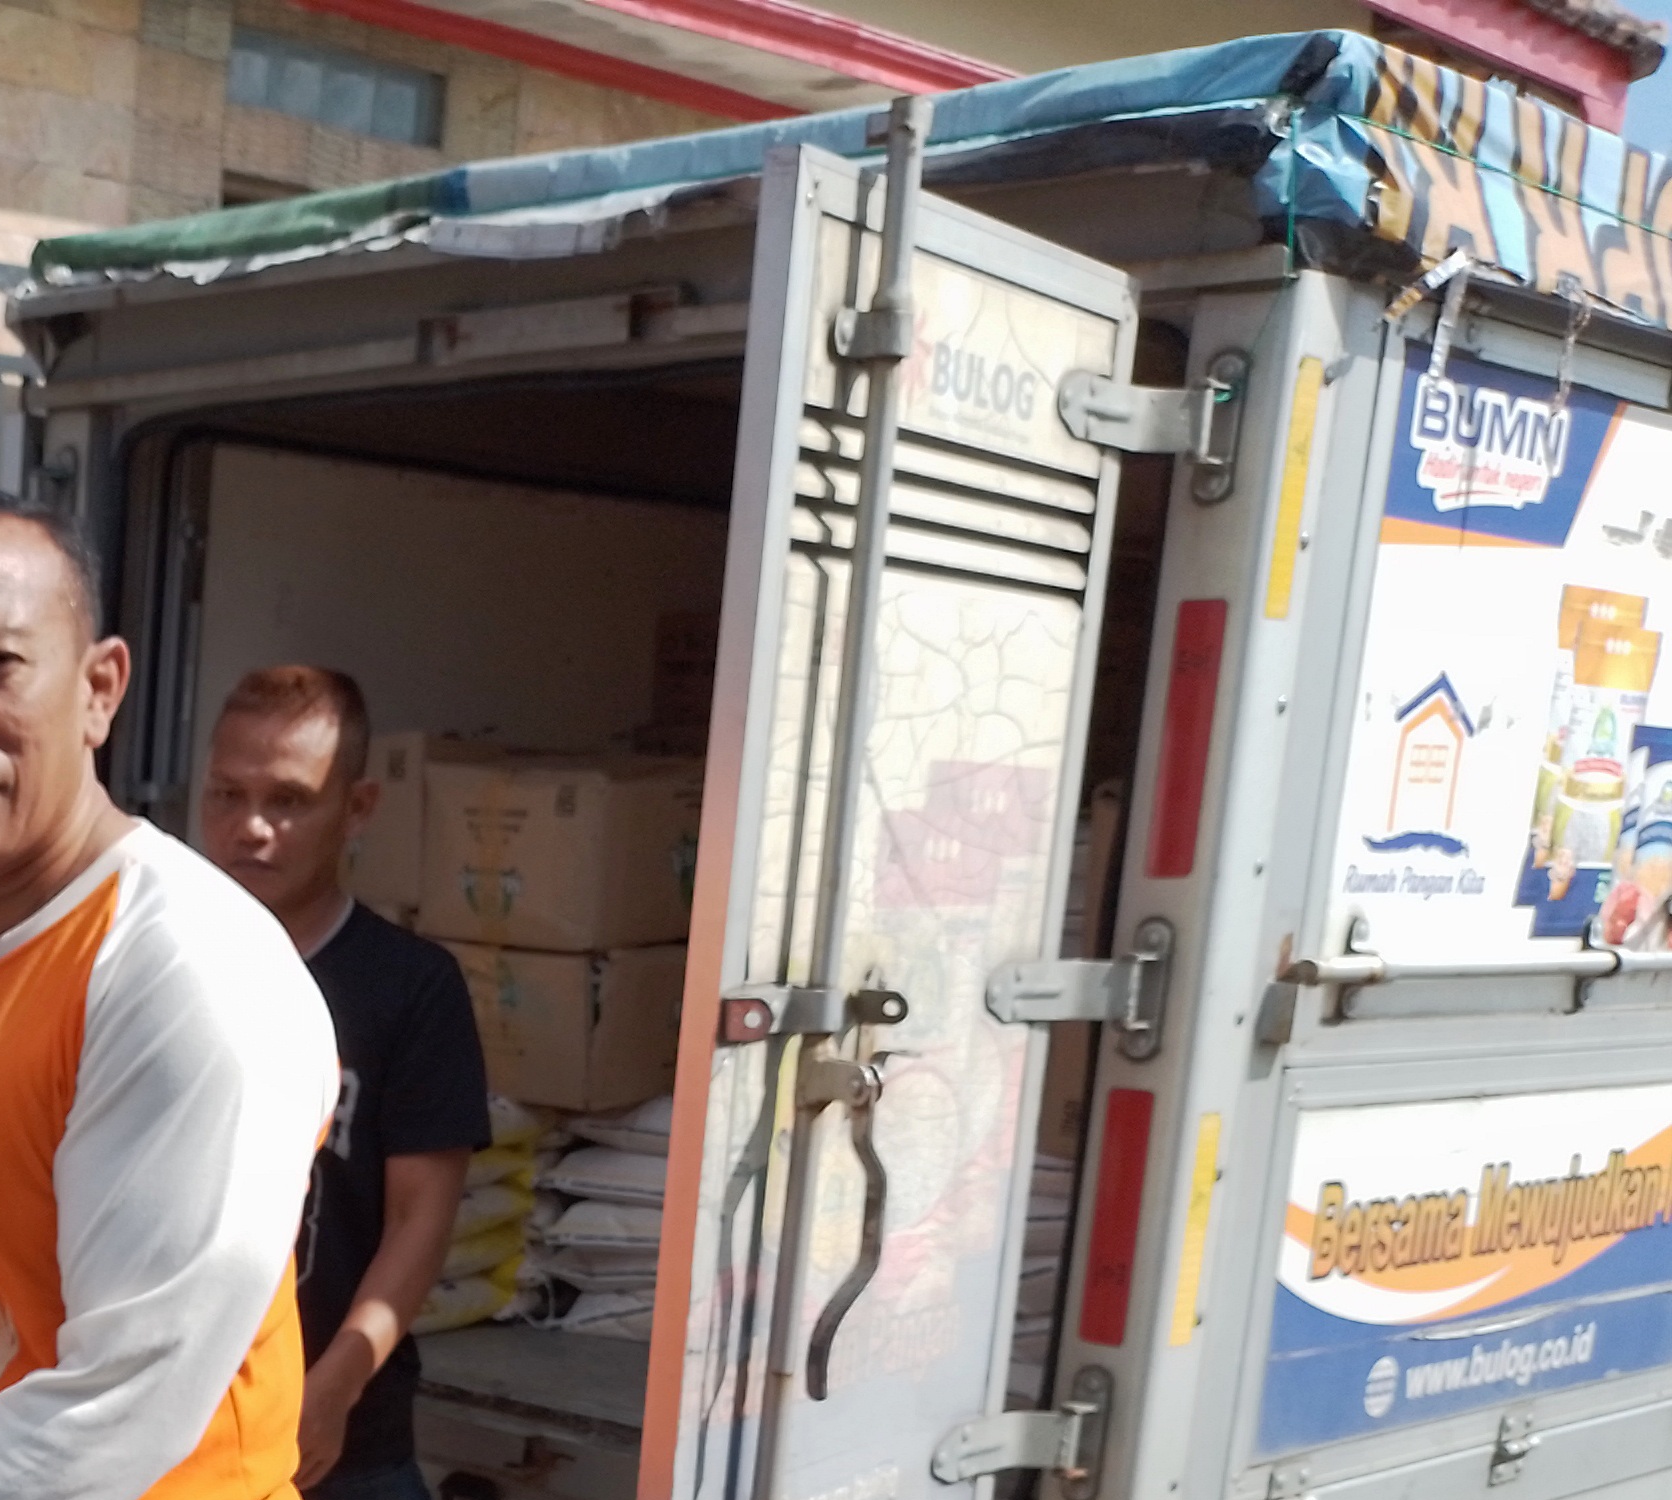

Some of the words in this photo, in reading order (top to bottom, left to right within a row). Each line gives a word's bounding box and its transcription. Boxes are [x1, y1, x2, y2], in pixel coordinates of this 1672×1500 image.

[931, 340, 1036, 422] BULOG
[1415, 384, 1566, 470] BUMN
[1307, 1181, 1468, 1281] Bersama
[1470, 1149, 1662, 1265] Mewujudkan
[1405, 1321, 1597, 1400] www.bulog.co.id
